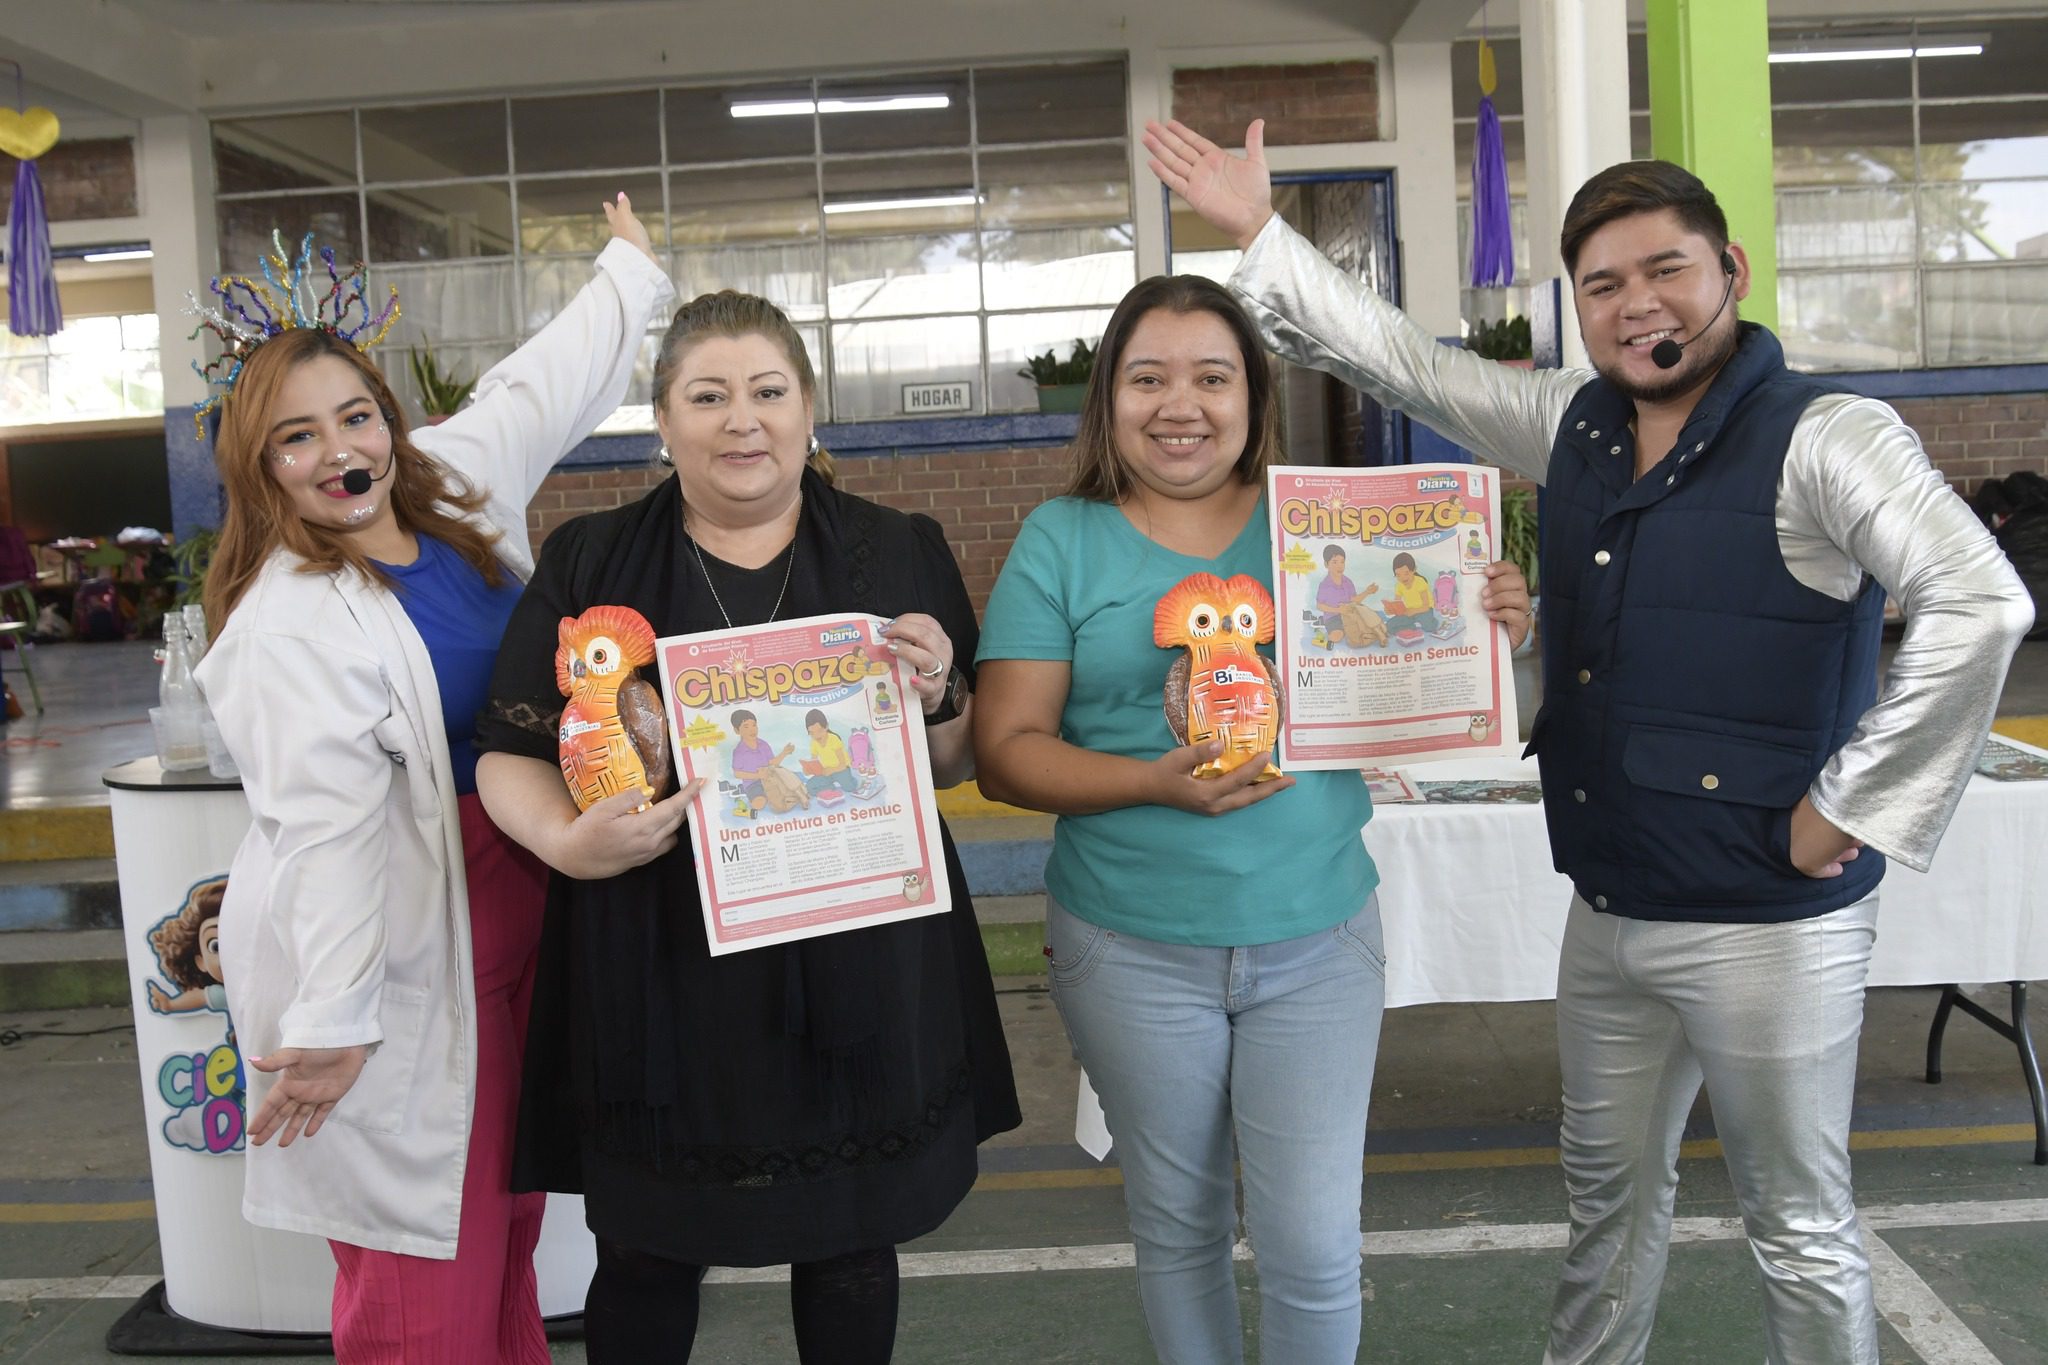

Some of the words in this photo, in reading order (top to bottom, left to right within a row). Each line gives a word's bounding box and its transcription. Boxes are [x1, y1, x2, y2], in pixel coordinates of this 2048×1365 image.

[912, 388, 962, 407] HOGAR
[1417, 479, 1459, 489] Diario
[1280, 498, 1462, 544] Chispazo
[1380, 532, 1441, 548] Educativo
[820, 630, 861, 643] Diario
[1298, 655, 1325, 668] Una
[1330, 653, 1399, 668] aventura
[1404, 650, 1422, 662] en
[1427, 645, 1480, 660] Semuc
[675, 653, 865, 708] Chispazo
[1215, 670, 1233, 684] Bi
[789, 687, 849, 704] Educativo
[719, 828, 751, 842] Una
[755, 815, 823, 836] aventura
[827, 810, 846, 825] en
[850, 803, 902, 821] Semuc
[159, 1045, 237, 1108] Cie
[202, 1097, 247, 1154] D
